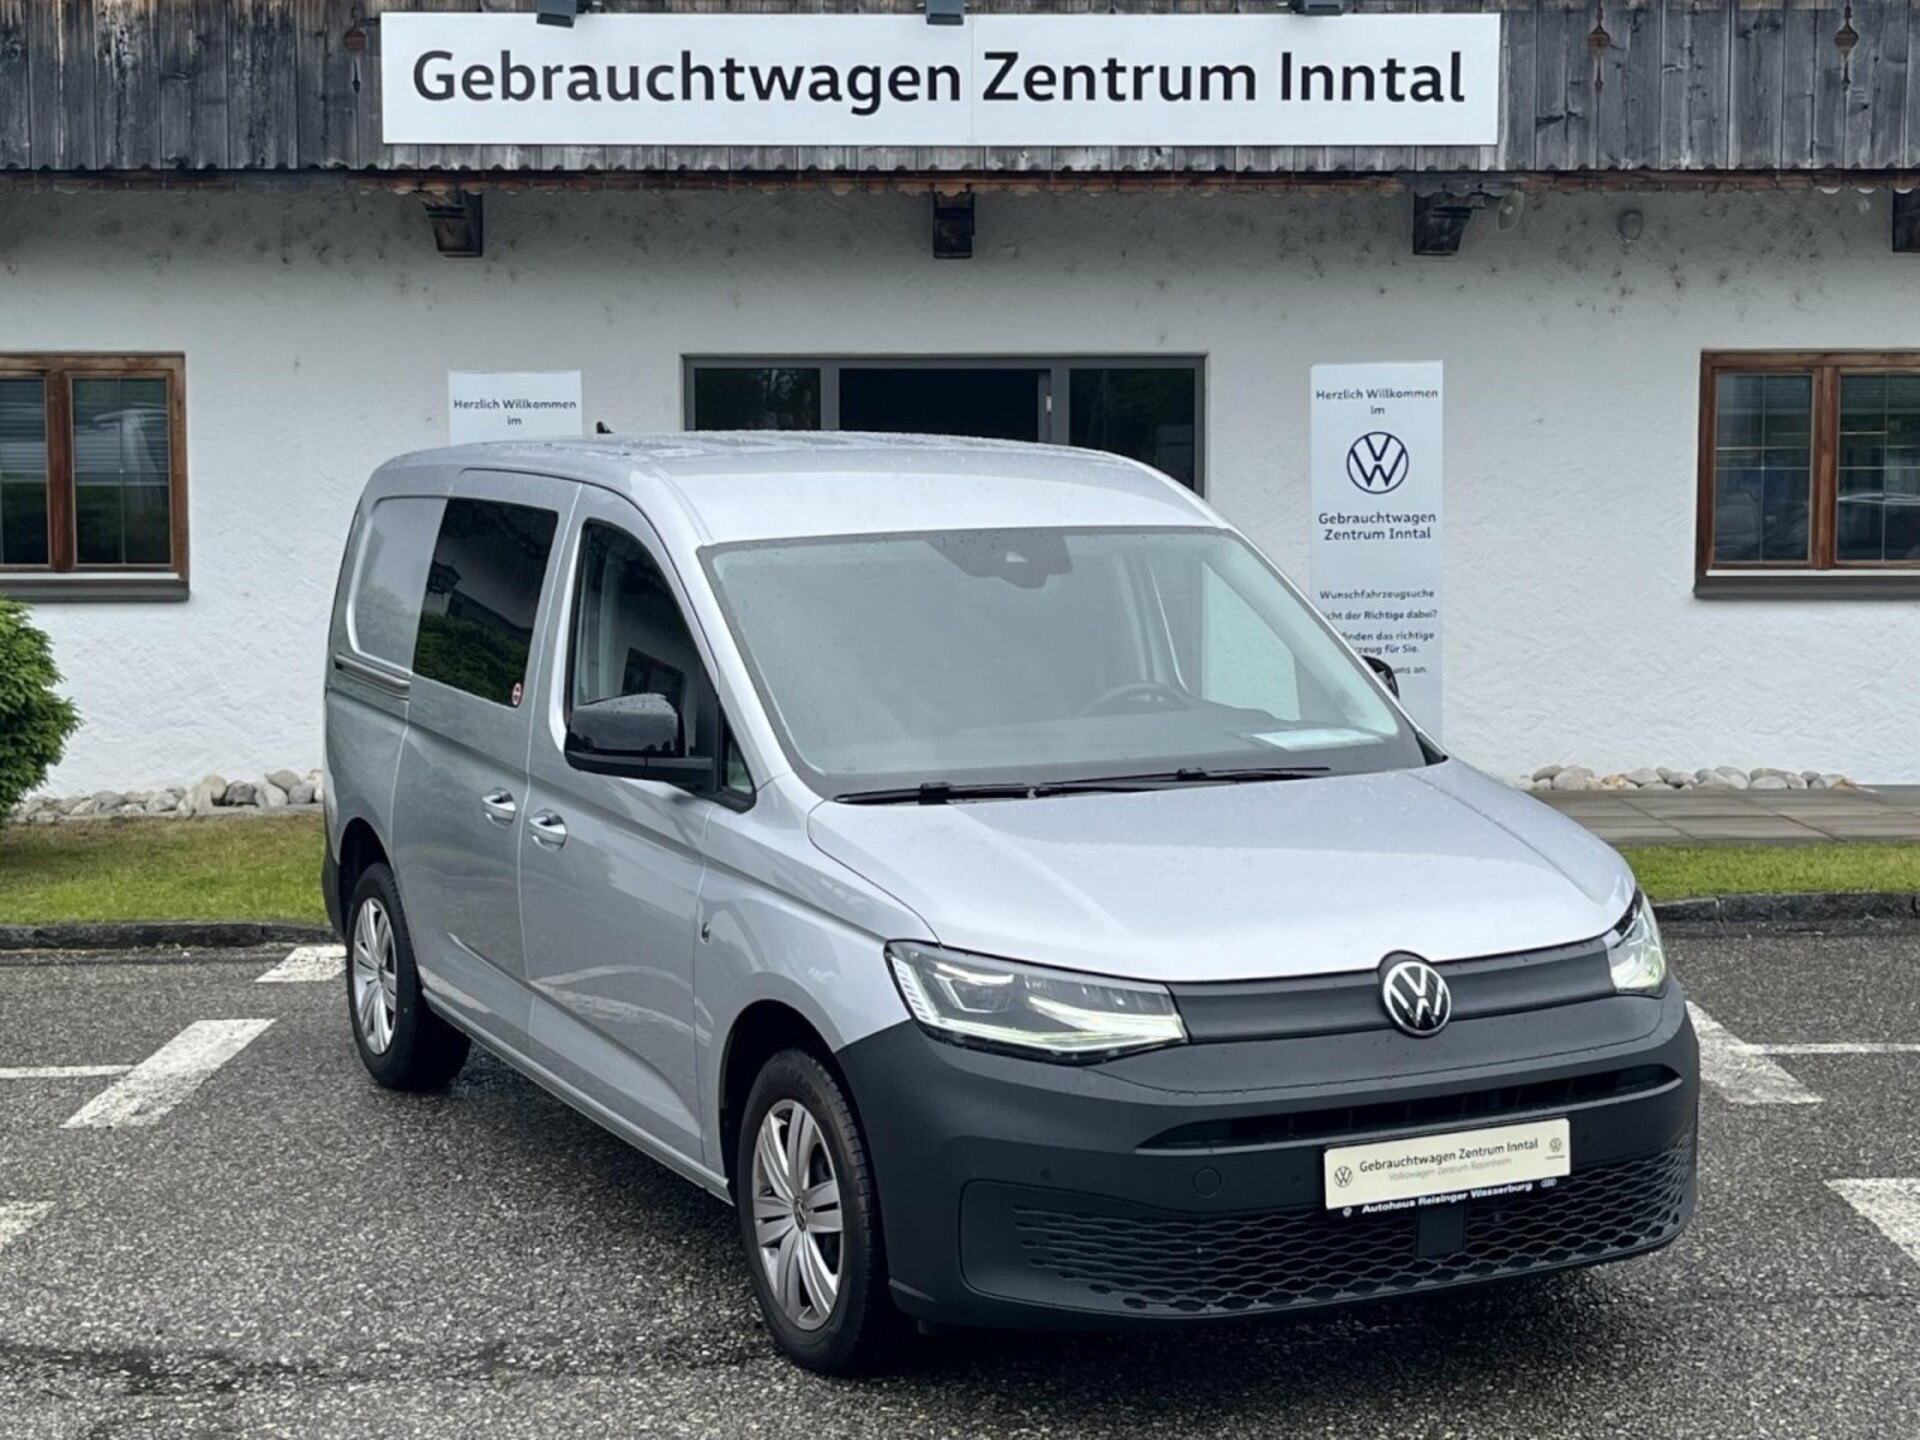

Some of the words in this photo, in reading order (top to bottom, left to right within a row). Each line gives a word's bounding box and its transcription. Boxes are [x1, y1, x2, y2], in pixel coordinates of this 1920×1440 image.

[413, 49, 961, 115] Gebrauchtwagen
[983, 51, 1256, 102] Zentrum
[1281, 51, 1465, 102] Inntal
[1316, 389, 1363, 400] Herzlich
[1366, 388, 1438, 399] Willkommen
[454, 399, 500, 409] Herzlich
[502, 399, 577, 409] Willkommen
[507, 416, 522, 425] im
[1318, 511, 1436, 526] Gebrauchtwagen
[1324, 528, 1385, 541] Zentrum
[1389, 527, 1431, 540] Inntal
[1320, 589, 1435, 600] Wunschfahrzeugsuche
[1345, 610, 1361, 620] der
[1364, 610, 1404, 621] Richtige
[1406, 609, 1438, 619] dabei?
[1376, 631, 1393, 641] das
[1396, 630, 1434, 641] richtige
[1385, 644, 1400, 653] für
[1360, 1153, 1456, 1172] Gebrauchtwagen
[1459, 1145, 1505, 1159] Zentrum
[1507, 1138, 1538, 1152] Inntal
[1362, 1199, 1416, 1214] Autohaus
[1418, 1192, 1468, 1206] Reisinger
[1470, 1183, 1533, 1199] Wasserburg
